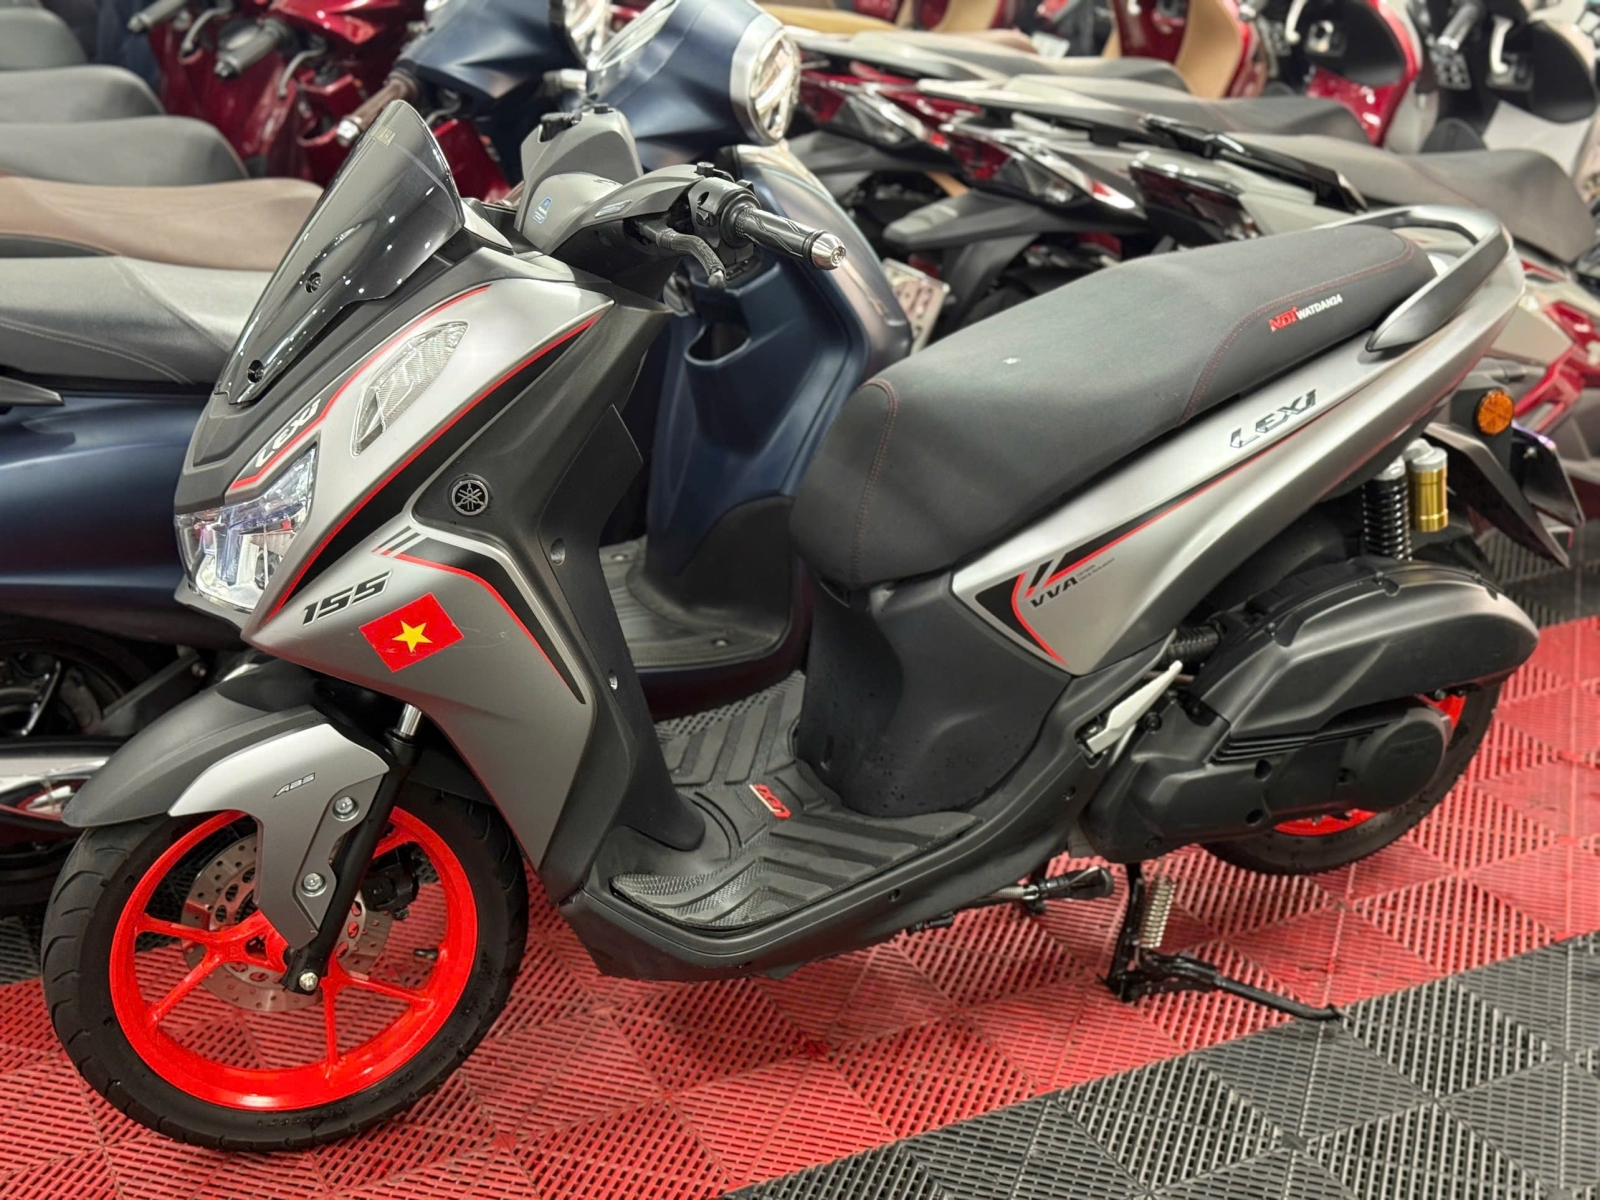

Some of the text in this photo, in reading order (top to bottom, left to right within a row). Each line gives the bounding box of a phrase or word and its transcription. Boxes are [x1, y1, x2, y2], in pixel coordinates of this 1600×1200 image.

[254, 398, 321, 468] LEXI
[1229, 388, 1316, 449] LEXI
[302, 568, 392, 626] 155
[1029, 576, 1078, 608] VVA
[272, 772, 316, 799] ABS
